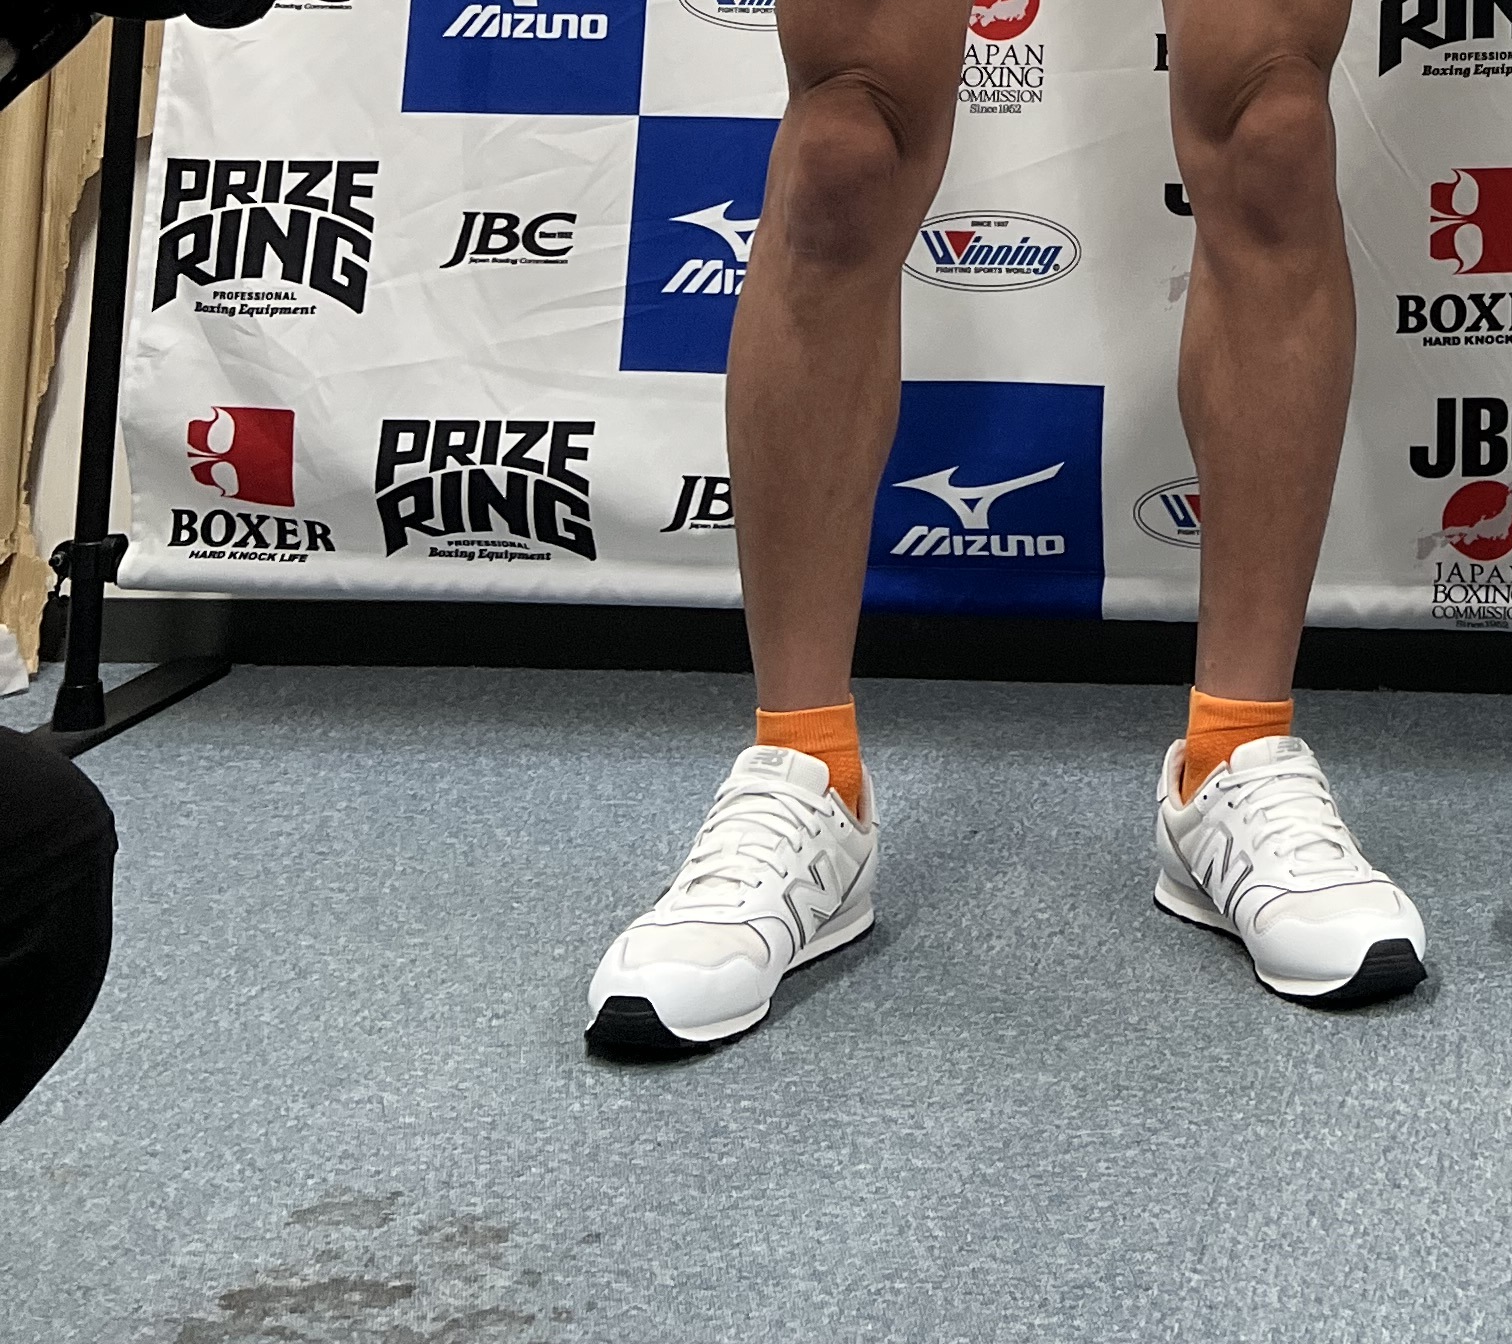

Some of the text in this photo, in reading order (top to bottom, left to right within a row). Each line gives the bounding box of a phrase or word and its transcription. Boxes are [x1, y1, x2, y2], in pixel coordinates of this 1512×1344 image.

[443, 5, 607, 39] MIZUNO
[1422, 64, 1471, 78] Boxing
[160, 158, 379, 233] PRIZE
[152, 207, 371, 314] RING
[440, 212, 577, 268] JBC
[921, 231, 1063, 275] Winning
[375, 420, 595, 497] PRIZE
[168, 509, 335, 551] BOXER
[376, 469, 597, 561] RING
[890, 525, 1065, 557] MIZUNO
